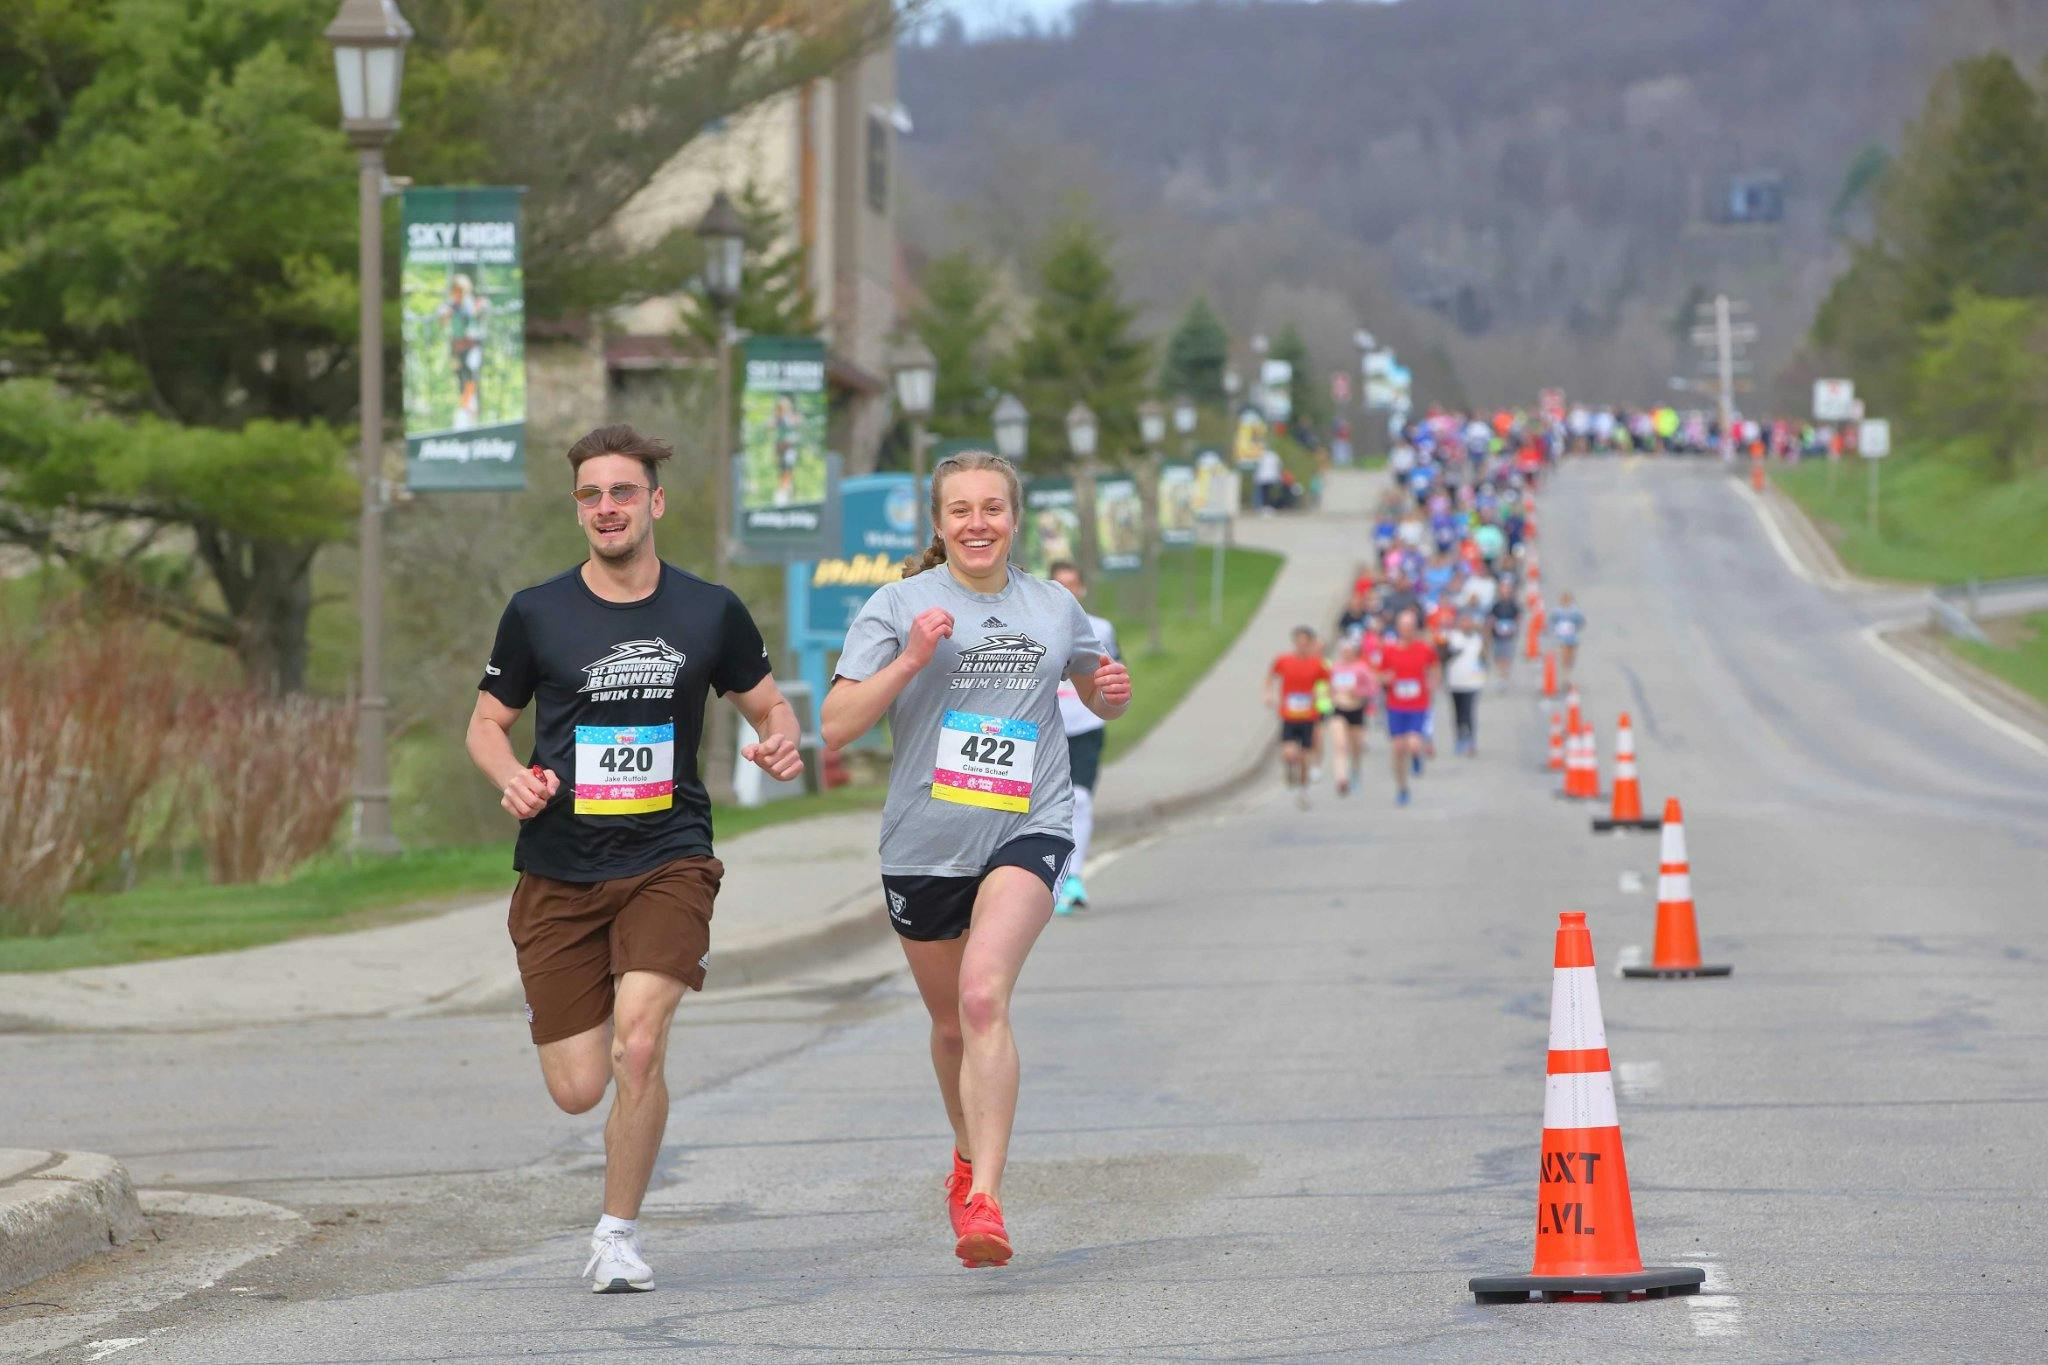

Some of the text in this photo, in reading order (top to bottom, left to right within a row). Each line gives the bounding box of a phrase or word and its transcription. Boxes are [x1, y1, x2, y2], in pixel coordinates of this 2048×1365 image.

[407, 221, 516, 247] SKY HIGH
[977, 653, 1039, 662] BONAVENTURE
[607, 663, 677, 674] BONAVENTURE
[960, 662, 1036, 673] BONNIES
[589, 672, 675, 688] BONNIES
[949, 678, 991, 690] SWIM
[1005, 678, 1040, 690] DIVE
[590, 689, 630, 703] SWIM
[642, 688, 675, 699] DIVE
[960, 735, 1015, 767] 422
[599, 747, 653, 772] 420
[962, 764, 983, 773] Claire
[1540, 1152, 1601, 1185] NXT
